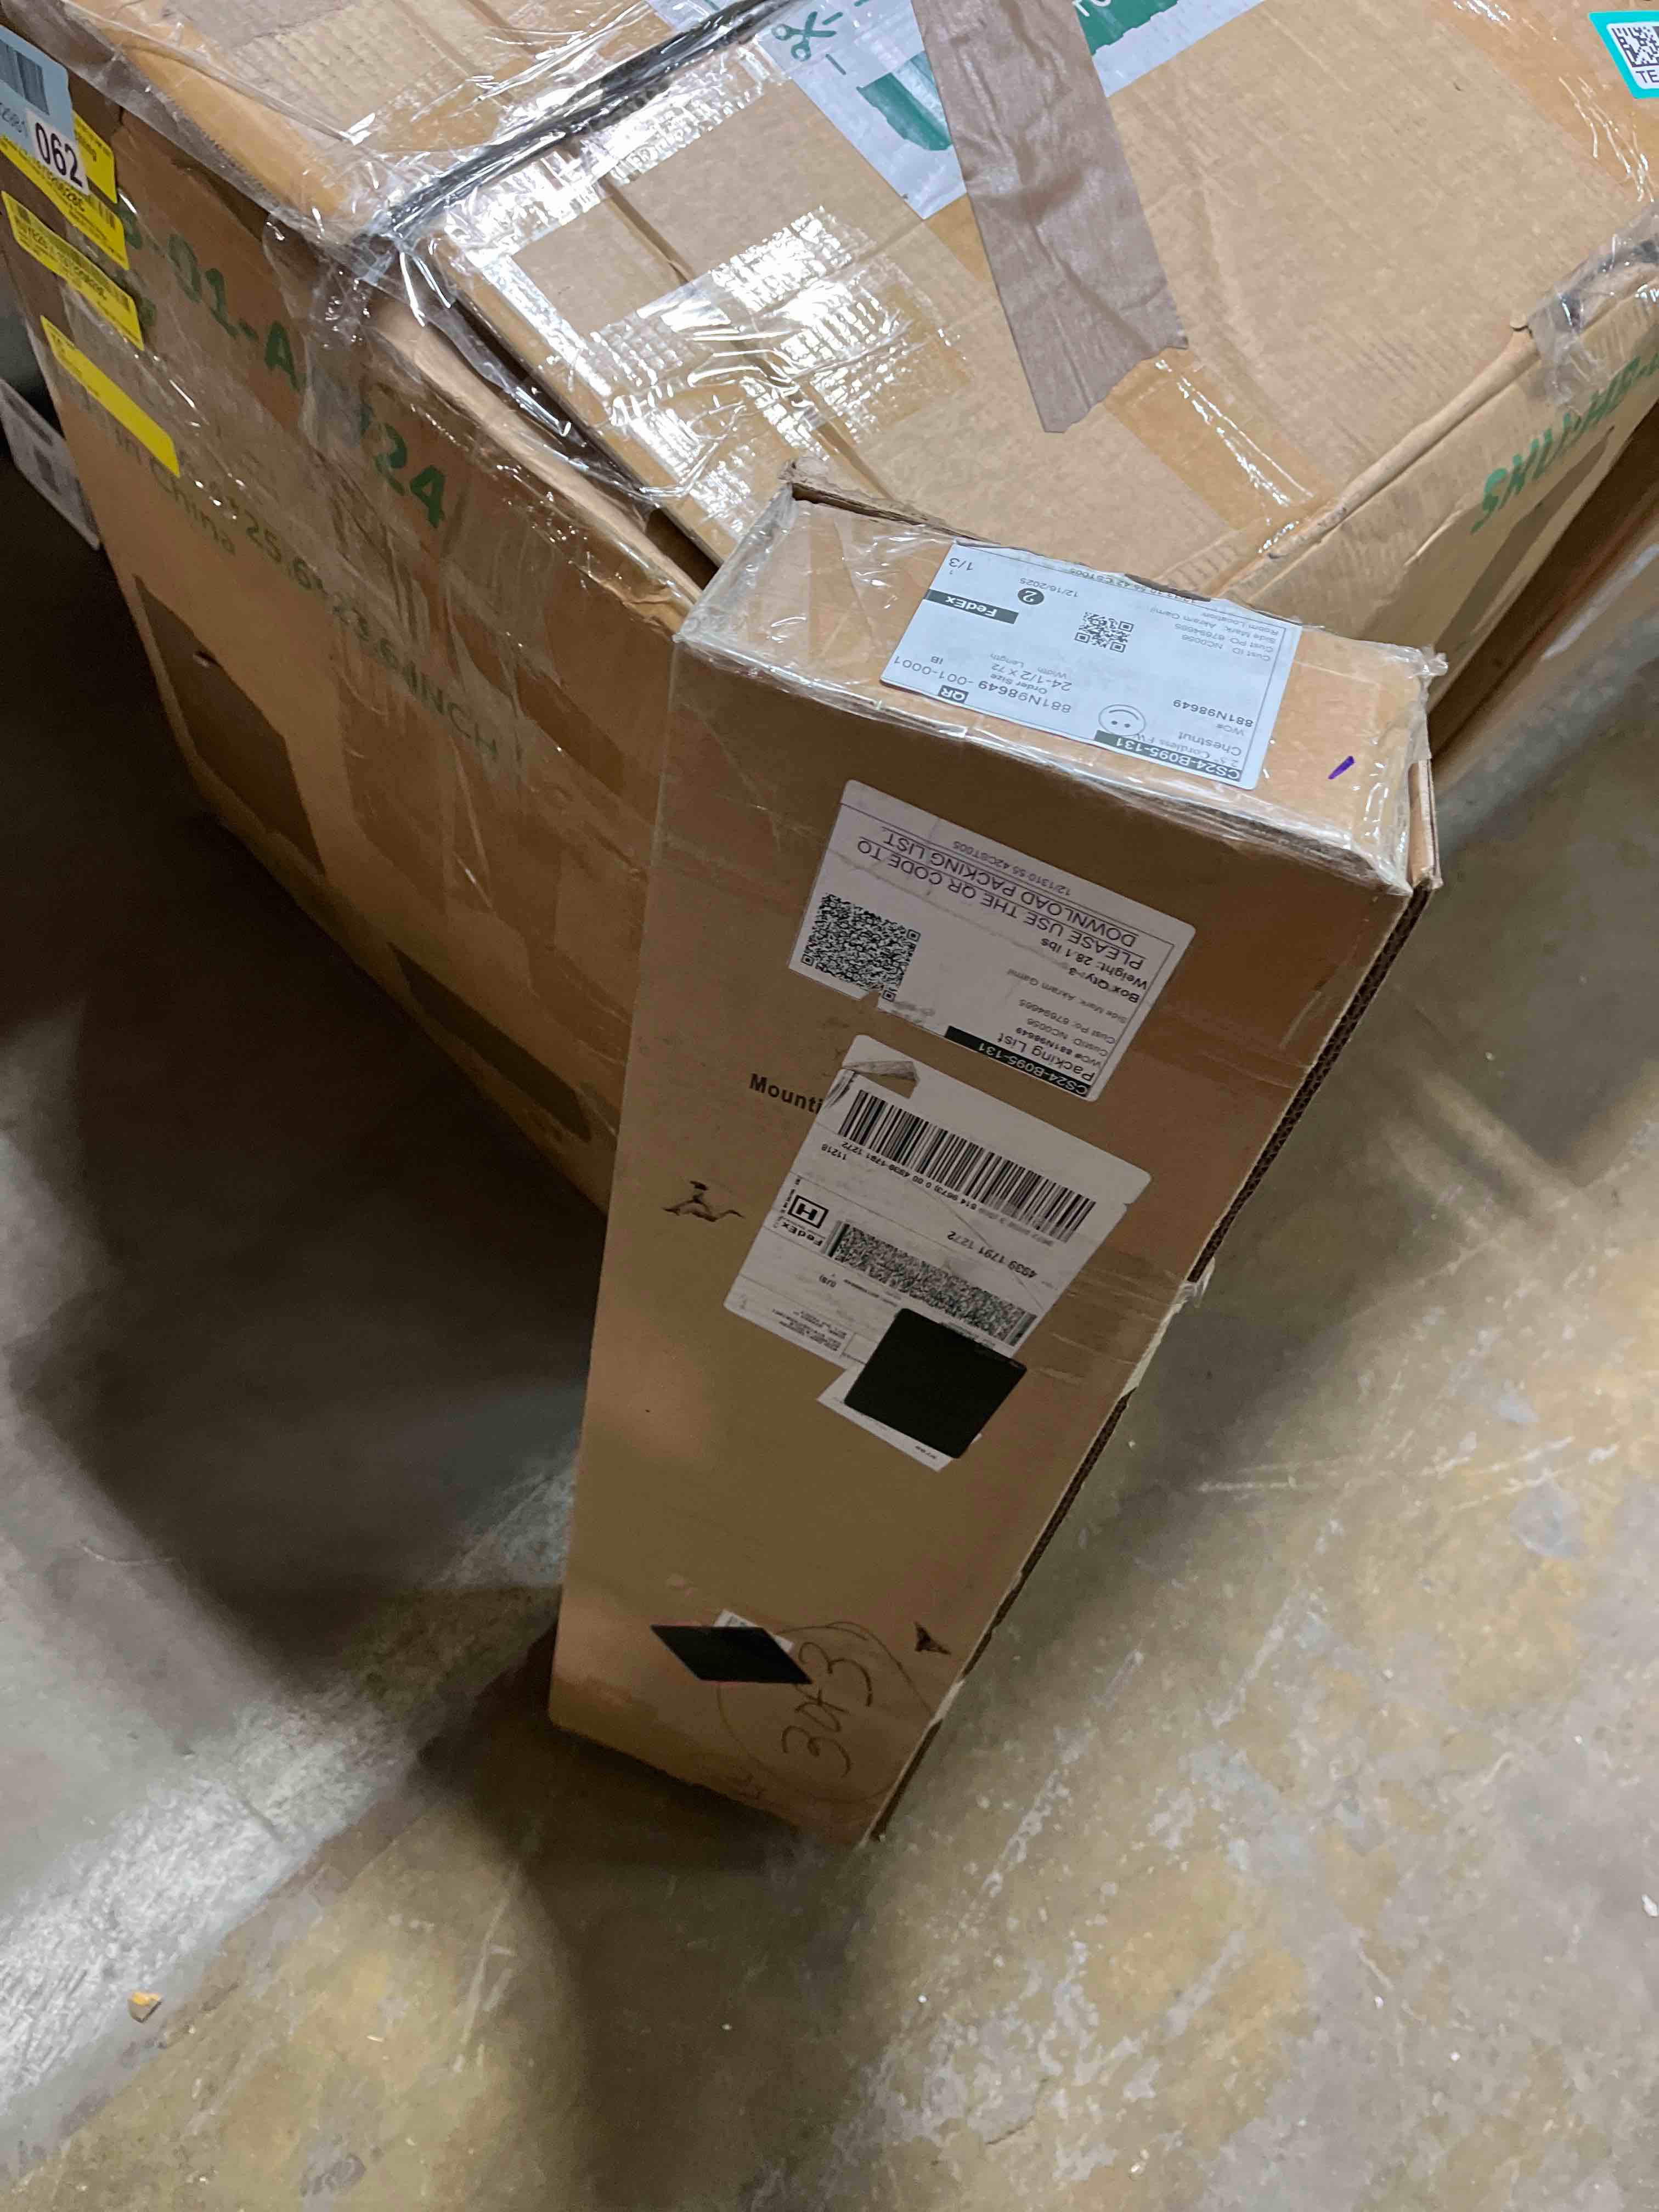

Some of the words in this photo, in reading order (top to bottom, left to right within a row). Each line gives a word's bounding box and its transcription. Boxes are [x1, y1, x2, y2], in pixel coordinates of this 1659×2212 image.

[35, 122, 83, 188] 062
[946, 557, 976, 572] 1/3
[944, 596, 997, 617] FedEx
[1021, 589, 1037, 603] 2
[990, 663, 1006, 673] 72
[1019, 669, 1073, 692] 24-1/2
[939, 686, 967, 701] QR
[977, 680, 1072, 714] 881N98649
[1172, 698, 1254, 727] 881N98649
[1158, 738, 1211, 760] Cordless
[1177, 731, 1242, 757] Chestnut
[1115, 736, 1240, 780] CS24-B095-131
[855, 838, 884, 861] TO
[887, 853, 944, 887] CODE
[929, 850, 1017, 898] PACKING
[946, 877, 978, 900] QR
[980, 892, 1020, 919] THE
[1018, 888, 1137, 949] DOWNLOAD
[1023, 910, 1065, 938] USE
[1038, 936, 1062, 953] lbs
[1066, 929, 1144, 971] PLEASE
[1064, 947, 1093, 967] 28.1
[1094, 958, 1150, 990] Weight:
[1110, 984, 1141, 1003] Box
[995, 1031, 1028, 1053] List
[1014, 1025, 1073, 1056] 881N98649
[978, 1041, 1088, 1096] CS24-B095-131
[1029, 1044, 1096, 1082] Packing
[841, 1140, 864, 1155] 1272
[780, 1220, 823, 1247] FedEx
[946, 1230, 975, 1249] 1272
[977, 1245, 1006, 1264] 1791
[1006, 1259, 1038, 1280] 4939
